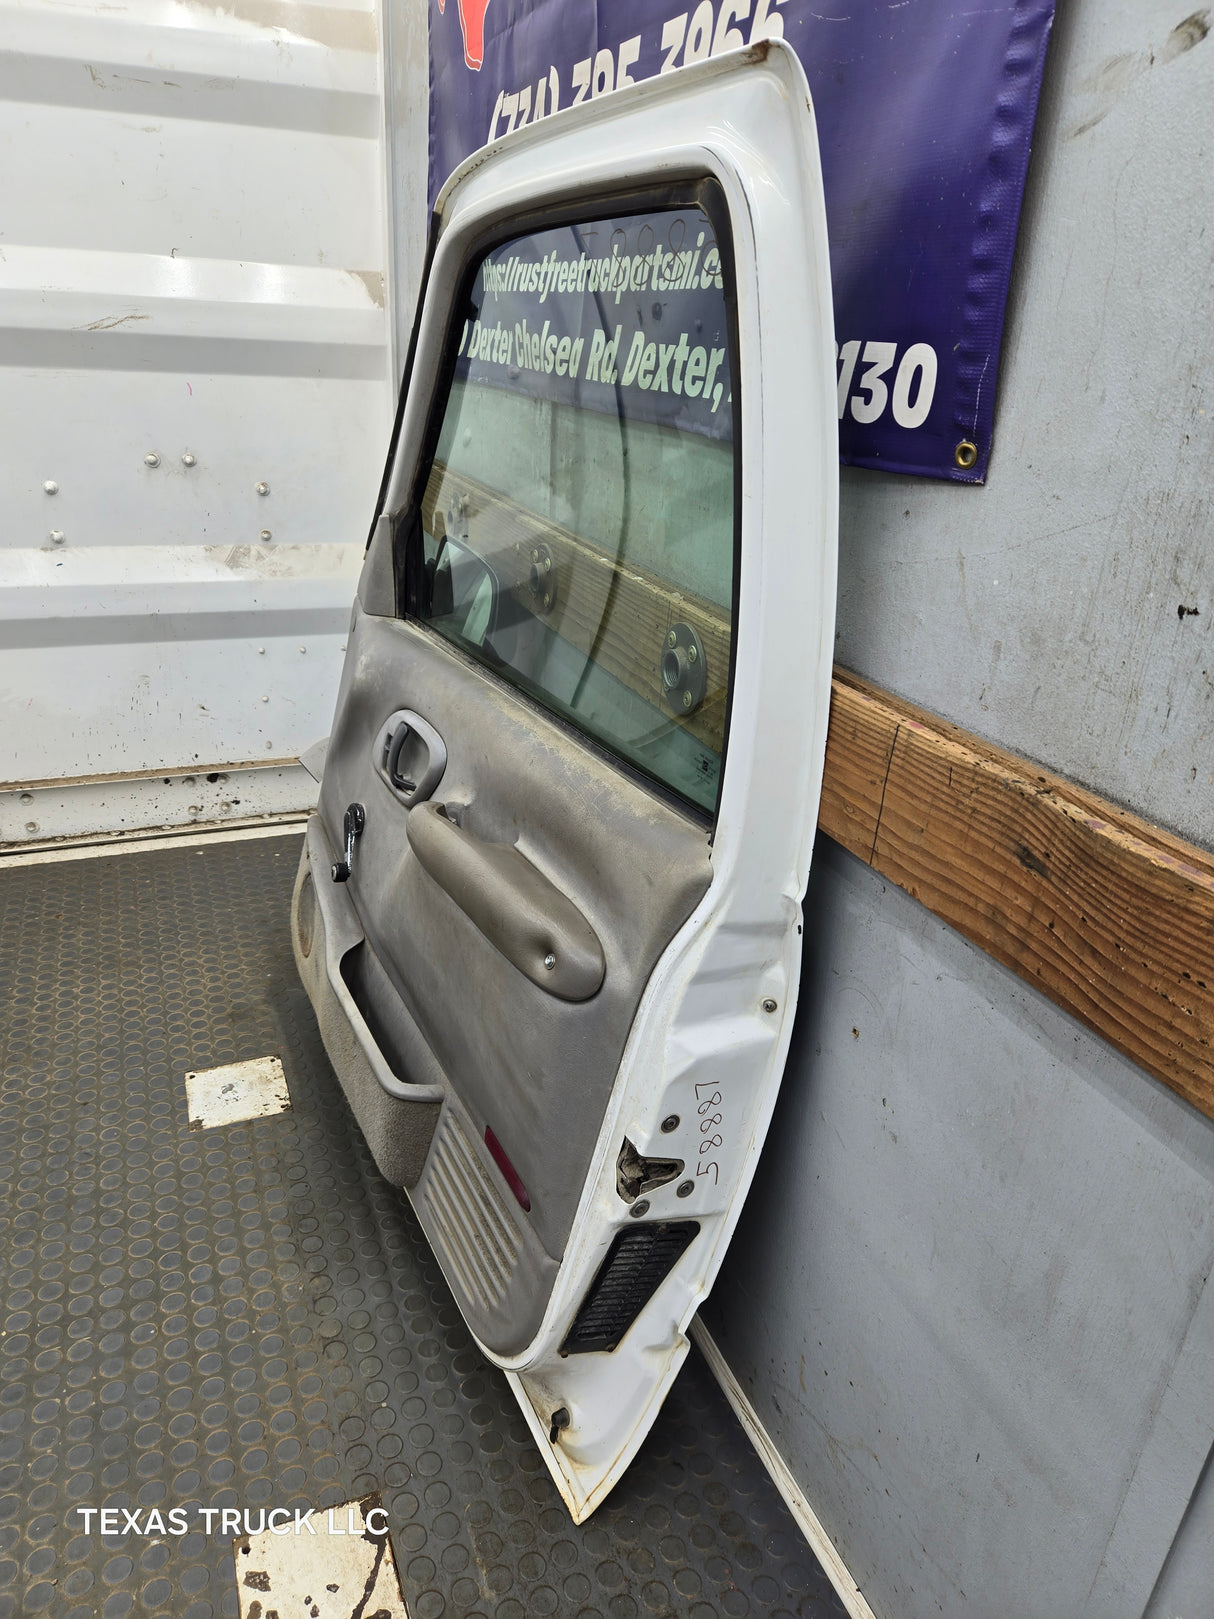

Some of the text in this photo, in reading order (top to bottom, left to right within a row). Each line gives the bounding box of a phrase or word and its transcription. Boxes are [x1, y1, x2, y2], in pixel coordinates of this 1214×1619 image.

[467, 319, 514, 365] Dexter
[515, 318, 585, 378] Chelsea
[585, 324, 623, 385] Rd.
[621, 331, 726, 413] Dexter,
[835, 339, 938, 429] 130
[694, 1080, 723, 1185] 58887
